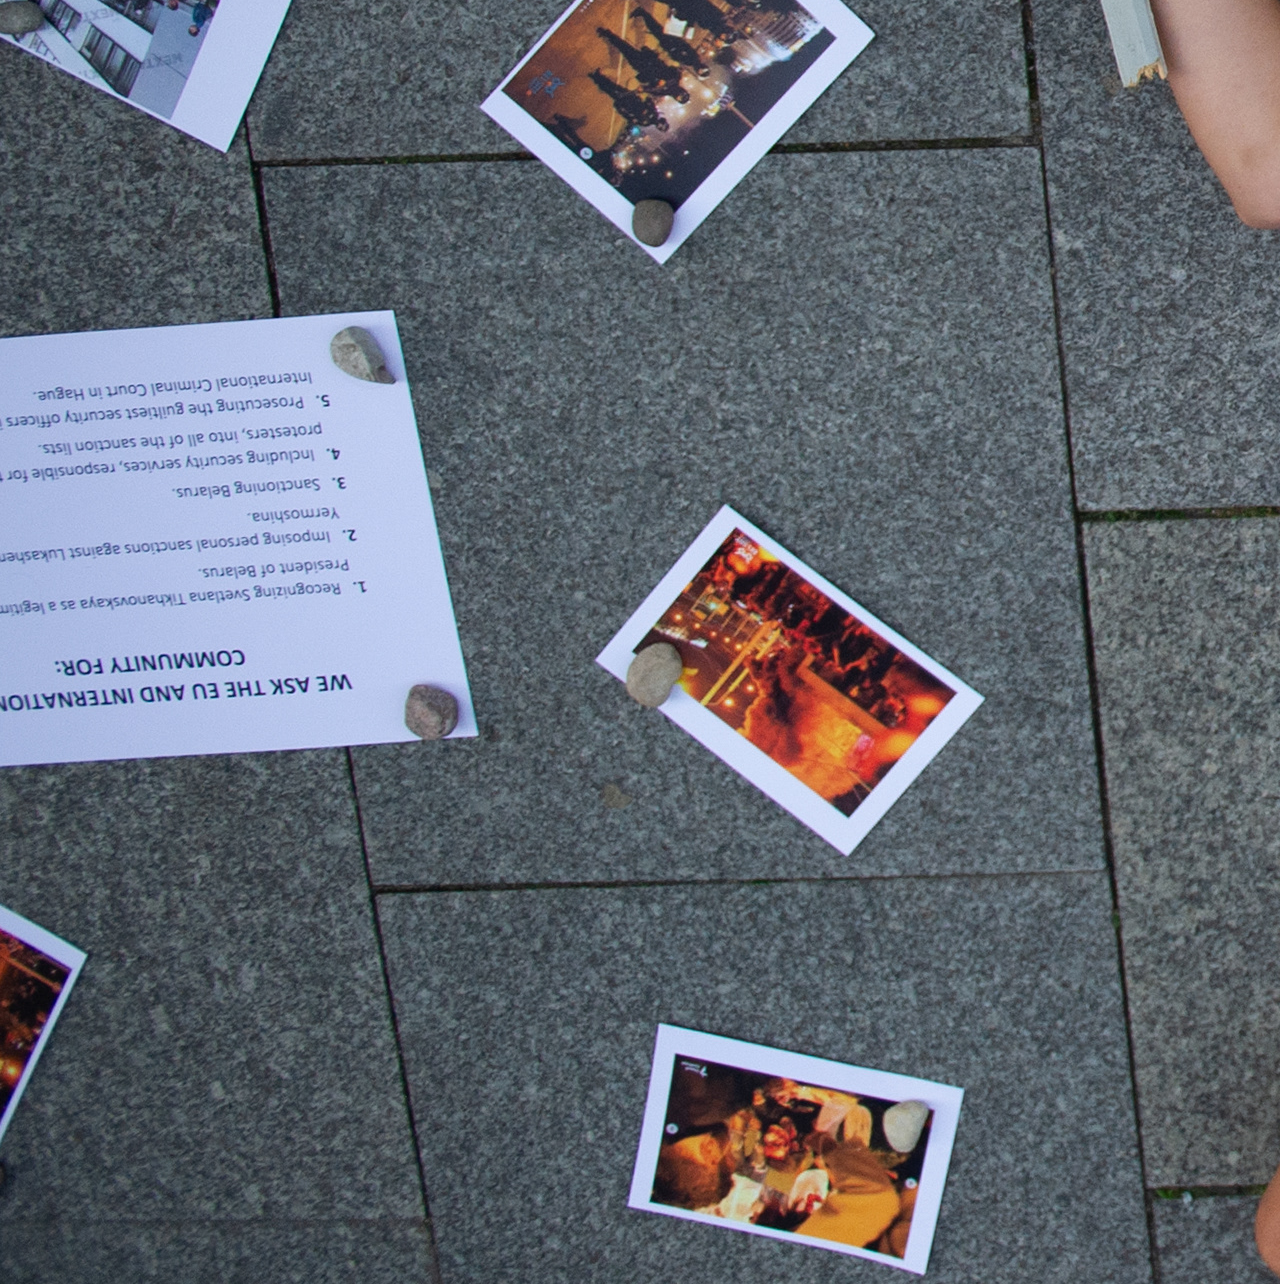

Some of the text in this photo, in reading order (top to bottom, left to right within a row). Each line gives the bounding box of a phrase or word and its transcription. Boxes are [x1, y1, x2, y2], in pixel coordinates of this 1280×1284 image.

[33, 372, 313, 401] International Criminal Court in Hague.
[188, 402, 214, 417] the
[215, 396, 305, 414] Prosecuting
[315, 394, 331, 408] 5.
[64, 409, 122, 425] security
[125, 401, 185, 420] guiltiest
[5, 413, 61, 428] officers
[38, 422, 323, 456] protesters, into all of the sanction lists.
[185, 454, 244, 470] security
[246, 449, 315, 465] Including
[326, 448, 341, 460] 4.
[31, 461, 116, 481] responsible
[119, 458, 182, 473] services,
[7, 469, 29, 483] for
[172, 476, 347, 499] 3. Sanctioning Belarus.
[247, 507, 340, 524] Yermoshina.
[196, 533, 260, 553] personal
[262, 529, 331, 547] Imposing
[342, 529, 358, 542] 2.
[68, 542, 121, 559] against
[124, 540, 193, 555] sanctions
[198, 559, 350, 580] President of Belarus.
[253, 582, 341, 600] Recognizing
[352, 580, 367, 593] 1.
[79, 593, 187, 611] Tikhanovskaya
[189, 588, 251, 604] Svetlana
[48, 601, 57, 611] a
[60, 600, 76, 611] as
[54, 649, 246, 677] COMMUNITY FOR:
[191, 682, 220, 700] EU
[223, 680, 267, 698] THE
[268, 676, 310, 696] ASK
[315, 673, 353, 692] WE
[139, 684, 185, 703] AND
